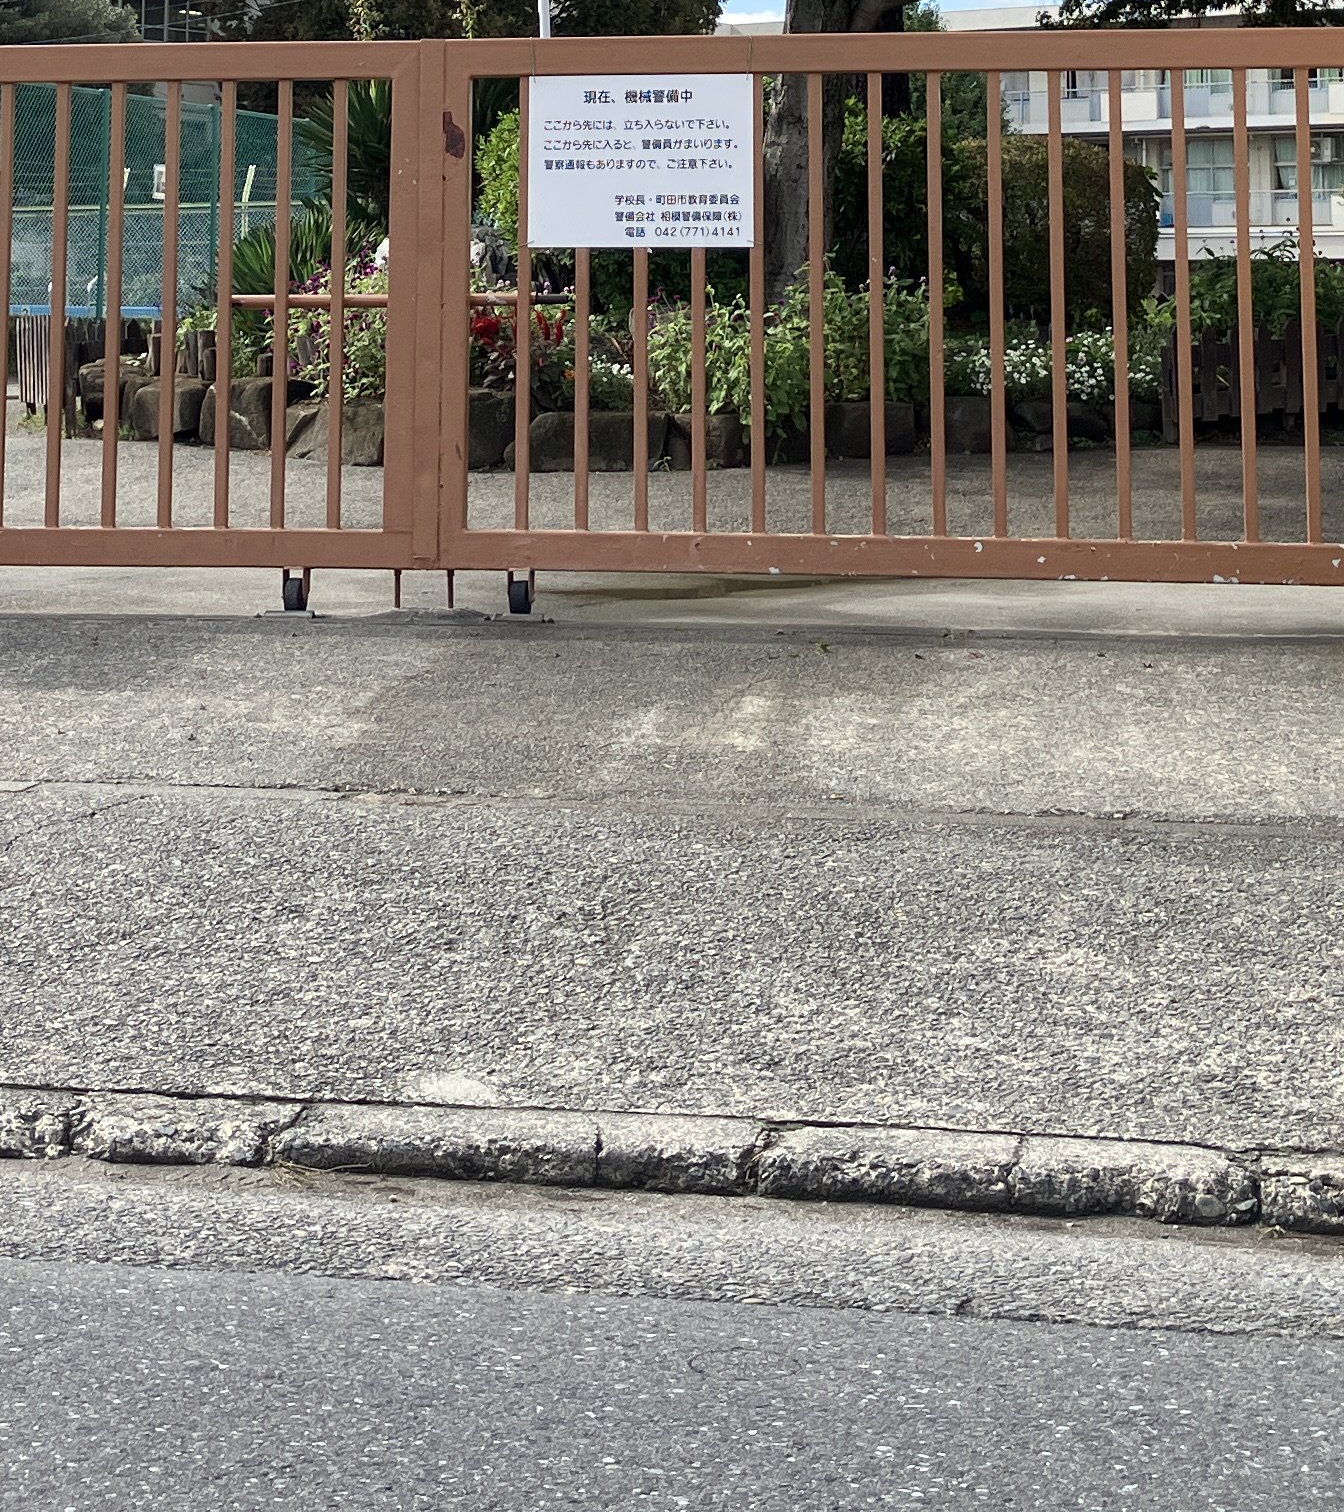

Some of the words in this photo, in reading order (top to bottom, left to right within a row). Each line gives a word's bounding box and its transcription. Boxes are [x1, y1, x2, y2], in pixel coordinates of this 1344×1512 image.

[583, 89, 693, 104] 現在、機械警備中
[624, 226, 646, 238] 電話
[654, 226, 741, 238] 042(771)4141
